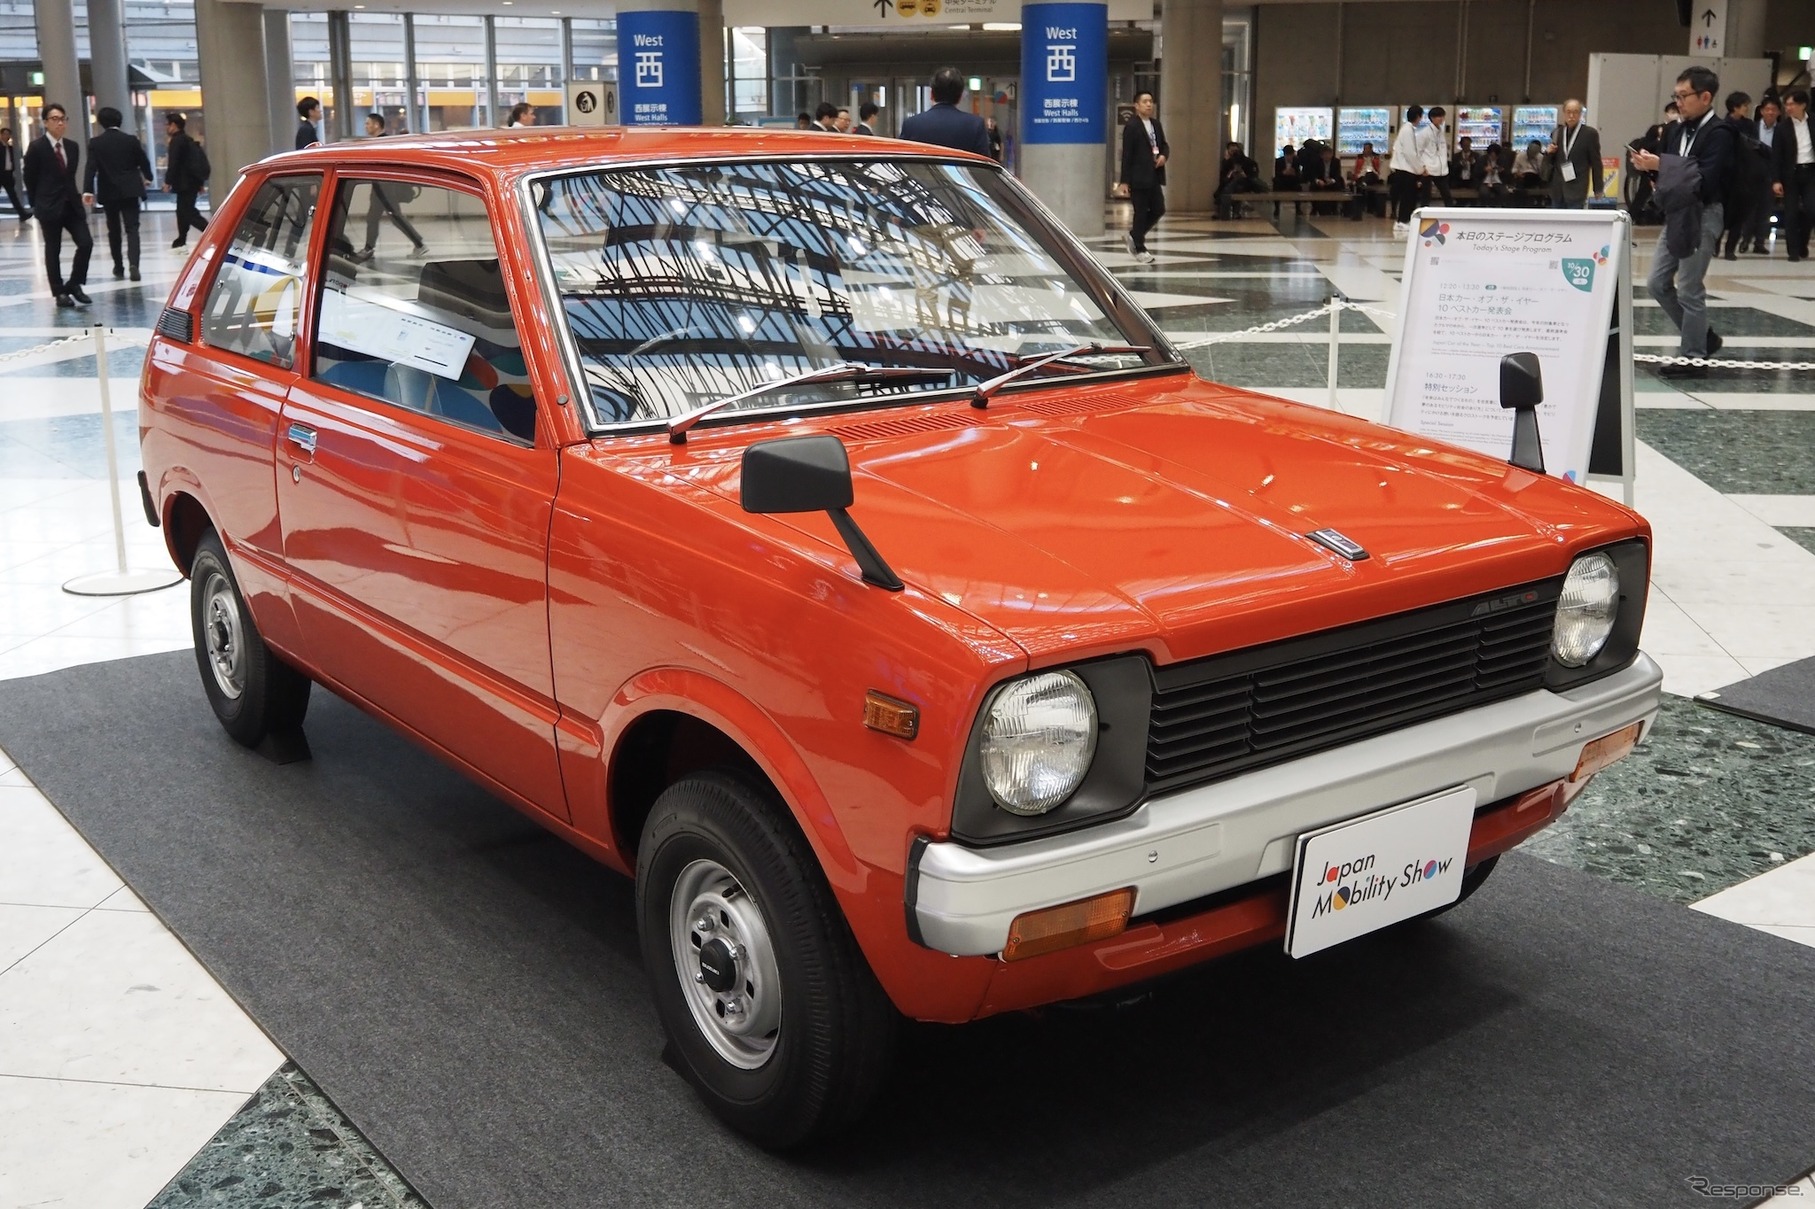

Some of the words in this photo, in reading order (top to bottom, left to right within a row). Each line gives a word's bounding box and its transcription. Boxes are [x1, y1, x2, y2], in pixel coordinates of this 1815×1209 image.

[1046, 26, 1077, 39] West
[633, 34, 664, 47] West
[1046, 45, 1076, 81] 西
[634, 52, 663, 87] 西
[634, 104, 667, 113] 西展示棟
[1044, 99, 1078, 108] 西展示棟
[1043, 109, 1060, 117] West
[1062, 109, 1079, 117] Halls
[1456, 231, 1573, 243] 本日のステージプログラム
[1473, 244, 1499, 252] Today's
[1500, 245, 1520, 253] Stage
[1522, 245, 1552, 253] Program
[1439, 304, 1449, 312] 10
[1451, 305, 1513, 315] ベストカー発表会
[1424, 382, 1479, 394] 特別セッション
[1471, 590, 1539, 617] ALTO
[1317, 854, 1375, 886] Japan
[1312, 874, 1398, 919] Mobility
[1400, 857, 1453, 888] Show
